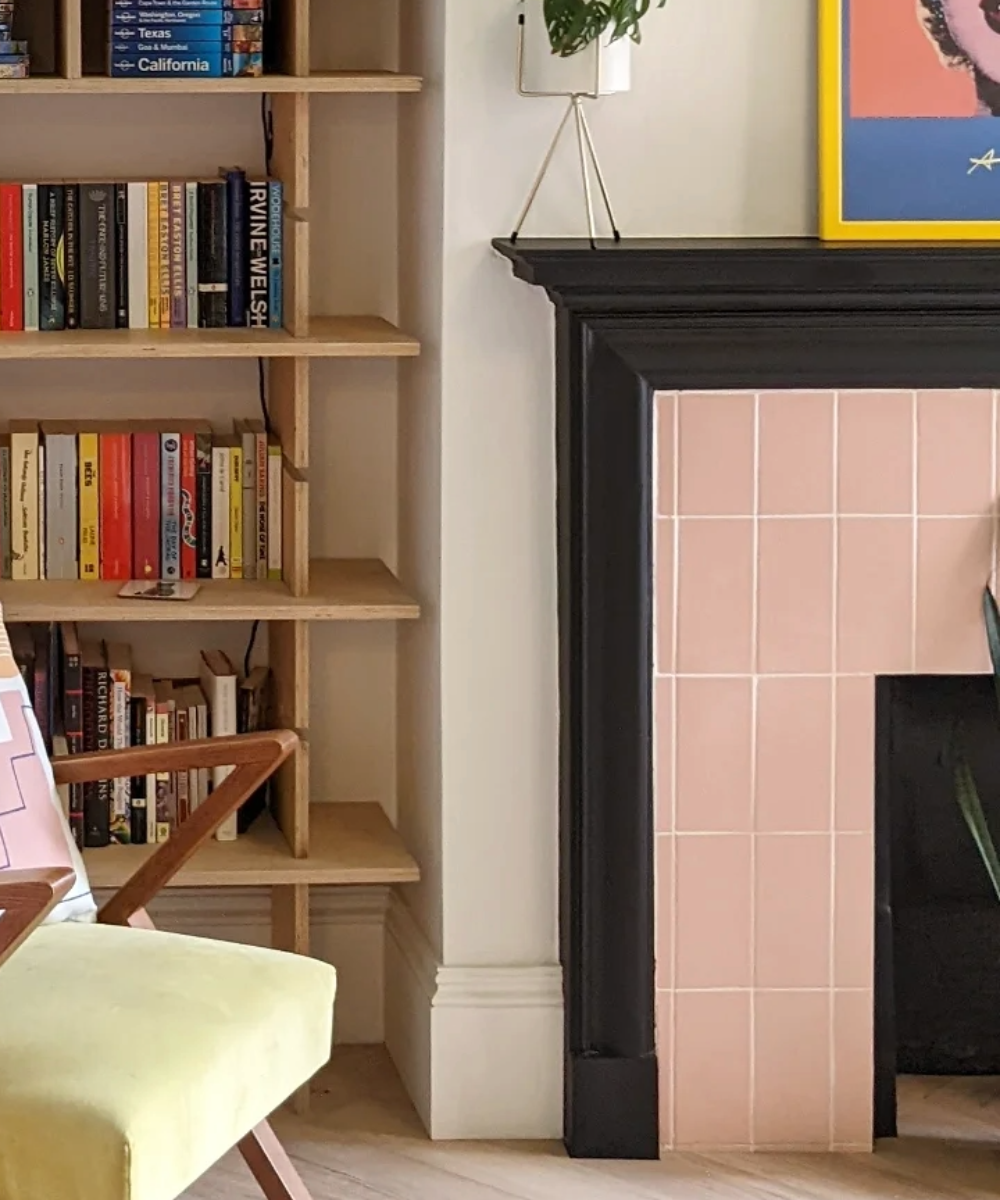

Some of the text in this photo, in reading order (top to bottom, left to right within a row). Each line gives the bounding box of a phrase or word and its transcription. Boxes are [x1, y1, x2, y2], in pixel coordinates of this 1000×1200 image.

[138, 28, 171, 38] Texas
[138, 57, 210, 72] California
[98, 204, 106, 221] THE
[272, 185, 281, 253] WODEHOUSE
[161, 217, 169, 260] EASTON
[172, 185, 182, 296] BRET EASTON ELLIS
[249, 182, 268, 328] IRVINE WELSH
[161, 264, 169, 294] ELLIS
[84, 461, 93, 486] BEES
[97, 671, 108, 800] RICHARD DINS
